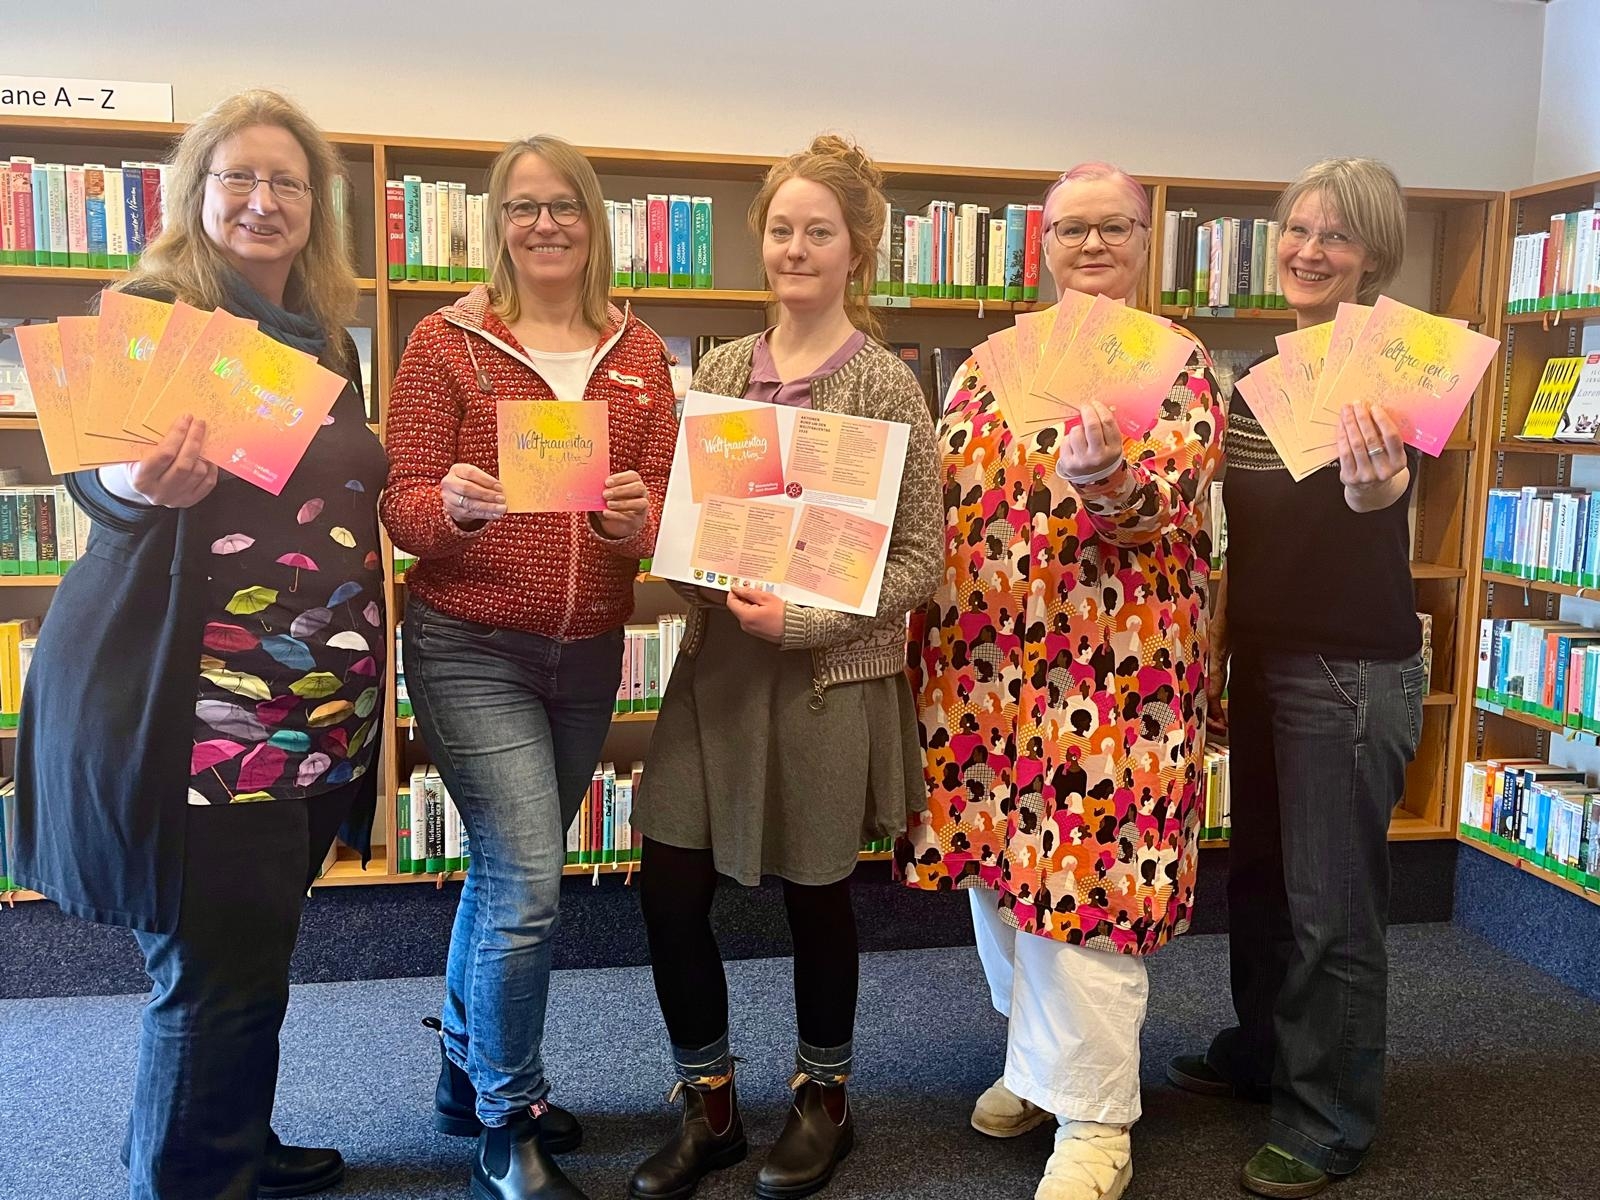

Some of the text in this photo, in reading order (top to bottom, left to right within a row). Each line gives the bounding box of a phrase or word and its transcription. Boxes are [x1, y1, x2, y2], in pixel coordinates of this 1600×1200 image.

[0, 88, 46, 106] ane
[54, 86, 72, 107] A
[100, 88, 116, 110] Z
[130, 212, 141, 244] Hundert
[390, 232, 404, 240] paul
[1238, 261, 1250, 288] Dalee
[886, 298, 893, 306] D
[1533, 392, 1569, 413] HAAS
[510, 429, 593, 459] Weltfrauentag
[700, 434, 768, 459] Weltfrauentag
